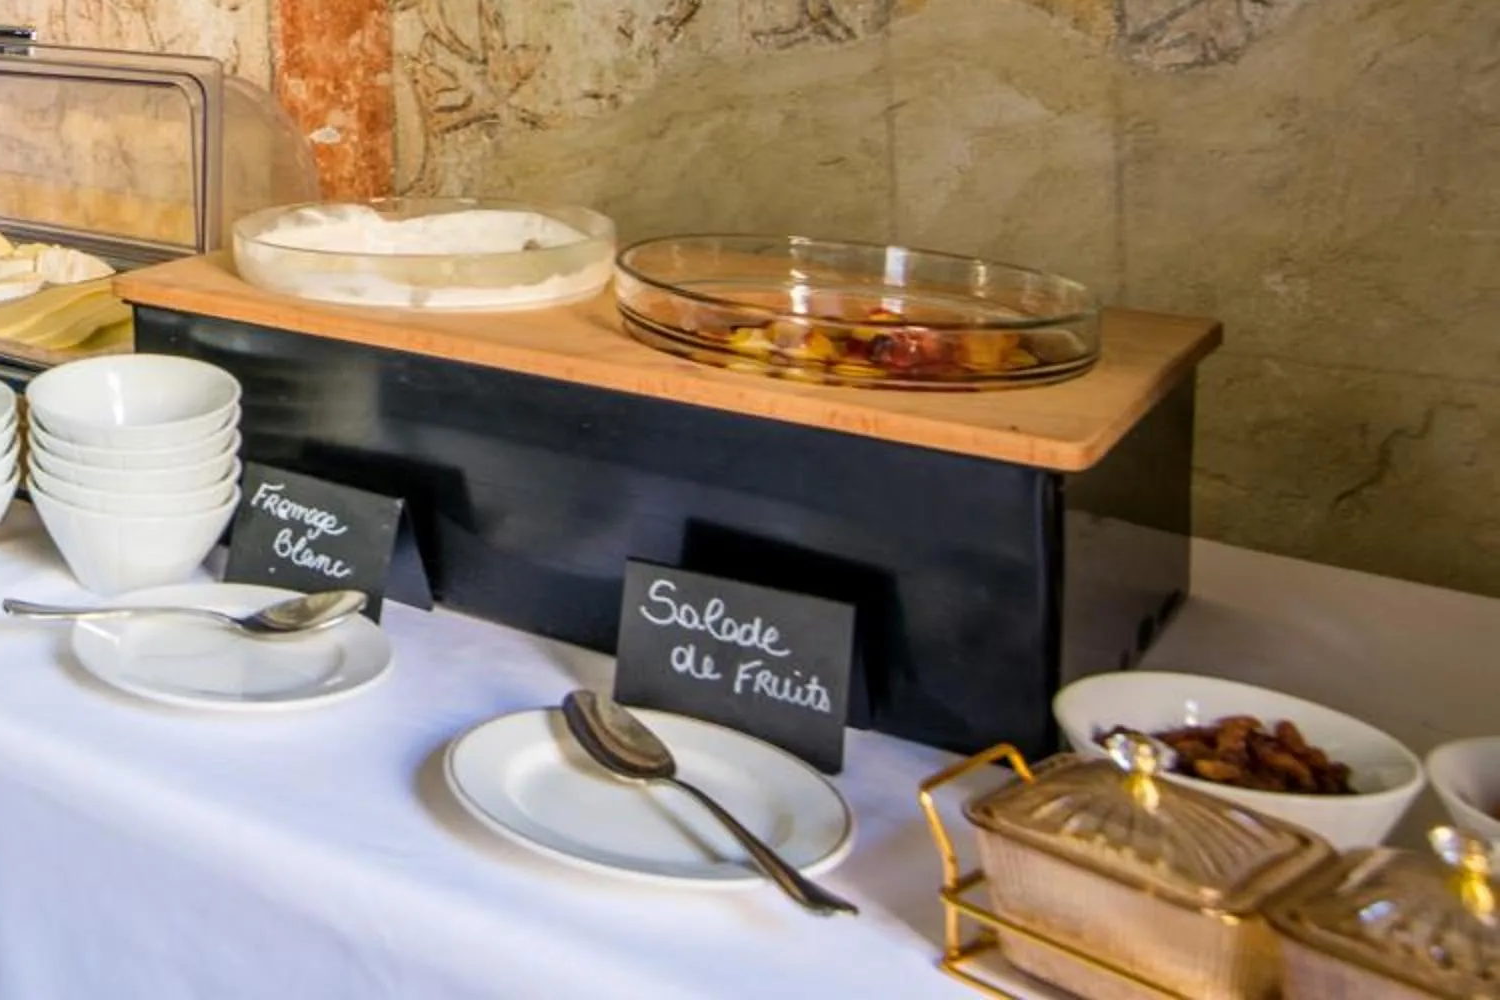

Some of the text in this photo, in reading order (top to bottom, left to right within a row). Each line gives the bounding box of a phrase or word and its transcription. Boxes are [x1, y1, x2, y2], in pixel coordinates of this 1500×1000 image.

[251, 482, 348, 538] Fromage
[273, 528, 351, 577] Blanc
[639, 579, 791, 656] Salade
[670, 643, 831, 713] de Fruits
